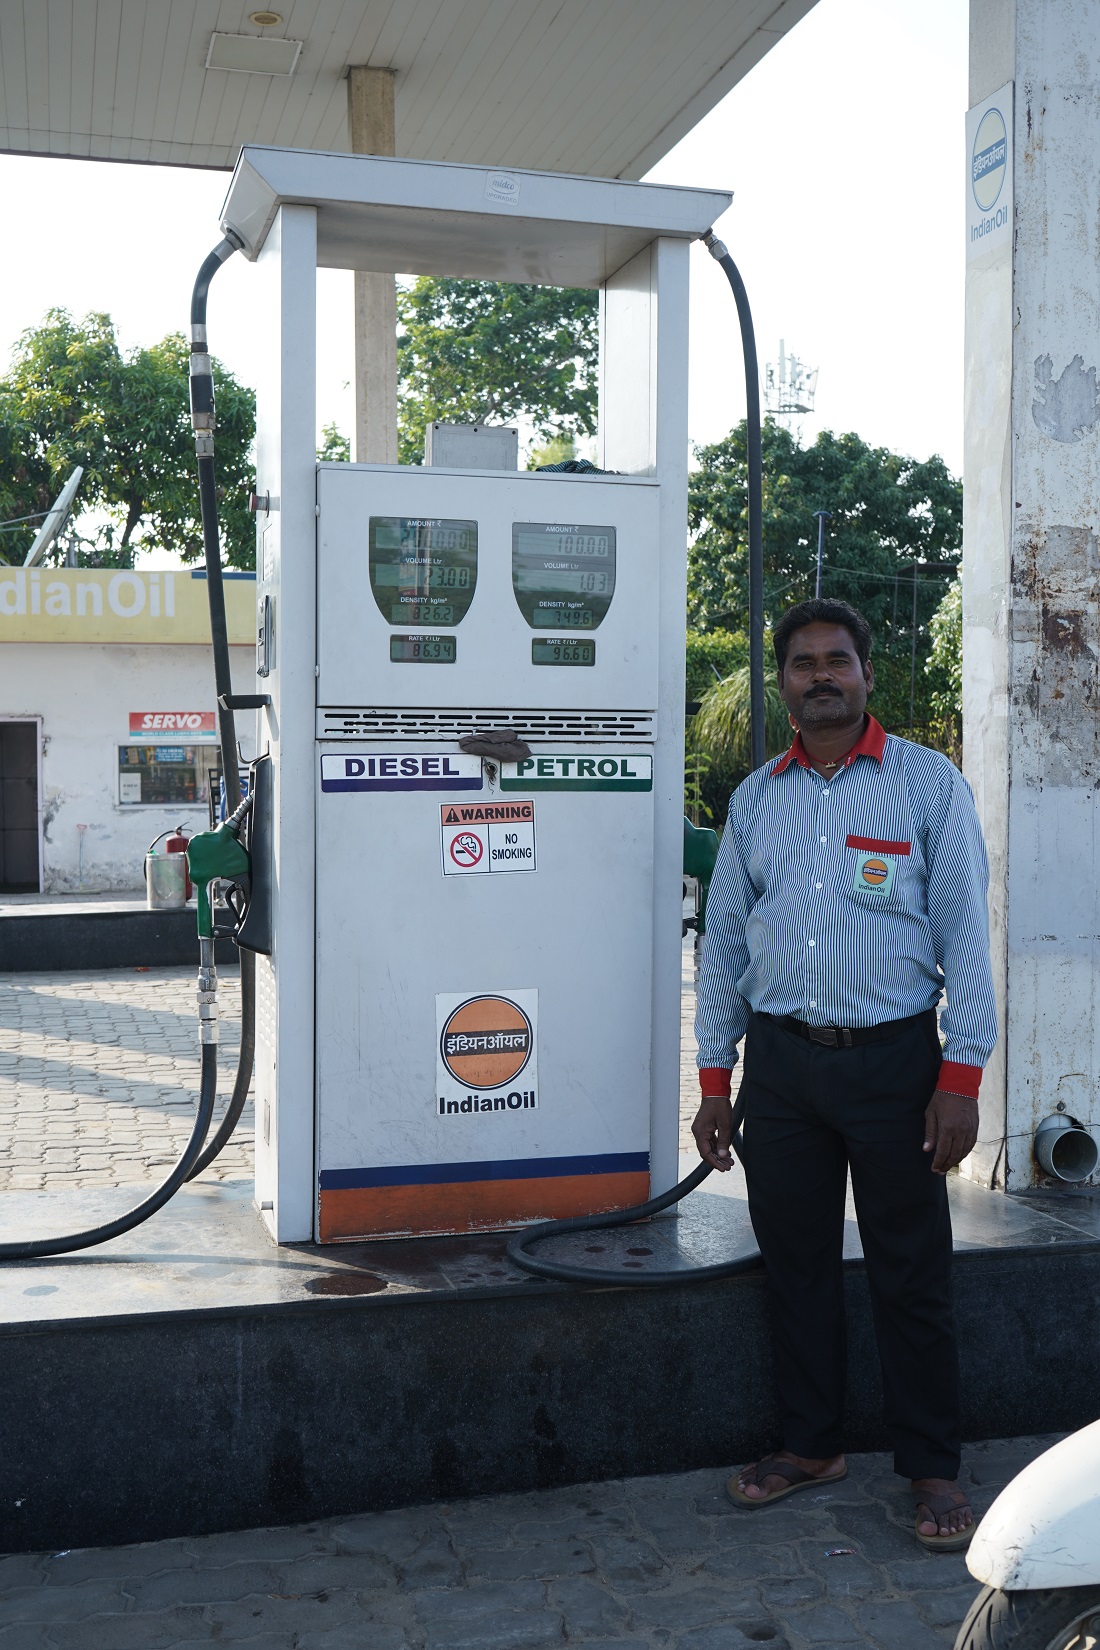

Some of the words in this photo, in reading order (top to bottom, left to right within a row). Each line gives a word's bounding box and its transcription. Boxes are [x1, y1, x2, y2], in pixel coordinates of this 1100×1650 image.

[486, 192, 517, 203] UPGRADED
[970, 205, 1008, 242] IndianOil
[558, 536, 606, 555] 100.00
[580, 573, 606, 592] 1.03
[412, 606, 451, 621] 826.2
[555, 610, 590, 625] 749.6
[412, 643, 451, 658] 86.94
[553, 646, 590, 661] 96.60
[141, 714, 202, 729] SERVO
[344, 757, 460, 777] DIESEL
[516, 758, 637, 778] PETROL
[460, 805, 532, 821] WARNING
[505, 833, 518, 845] NO
[491, 847, 532, 860] SMOKING
[446, 1033, 528, 1054] इंडियनऑयल
[439, 1090, 536, 1115] IndianOil
